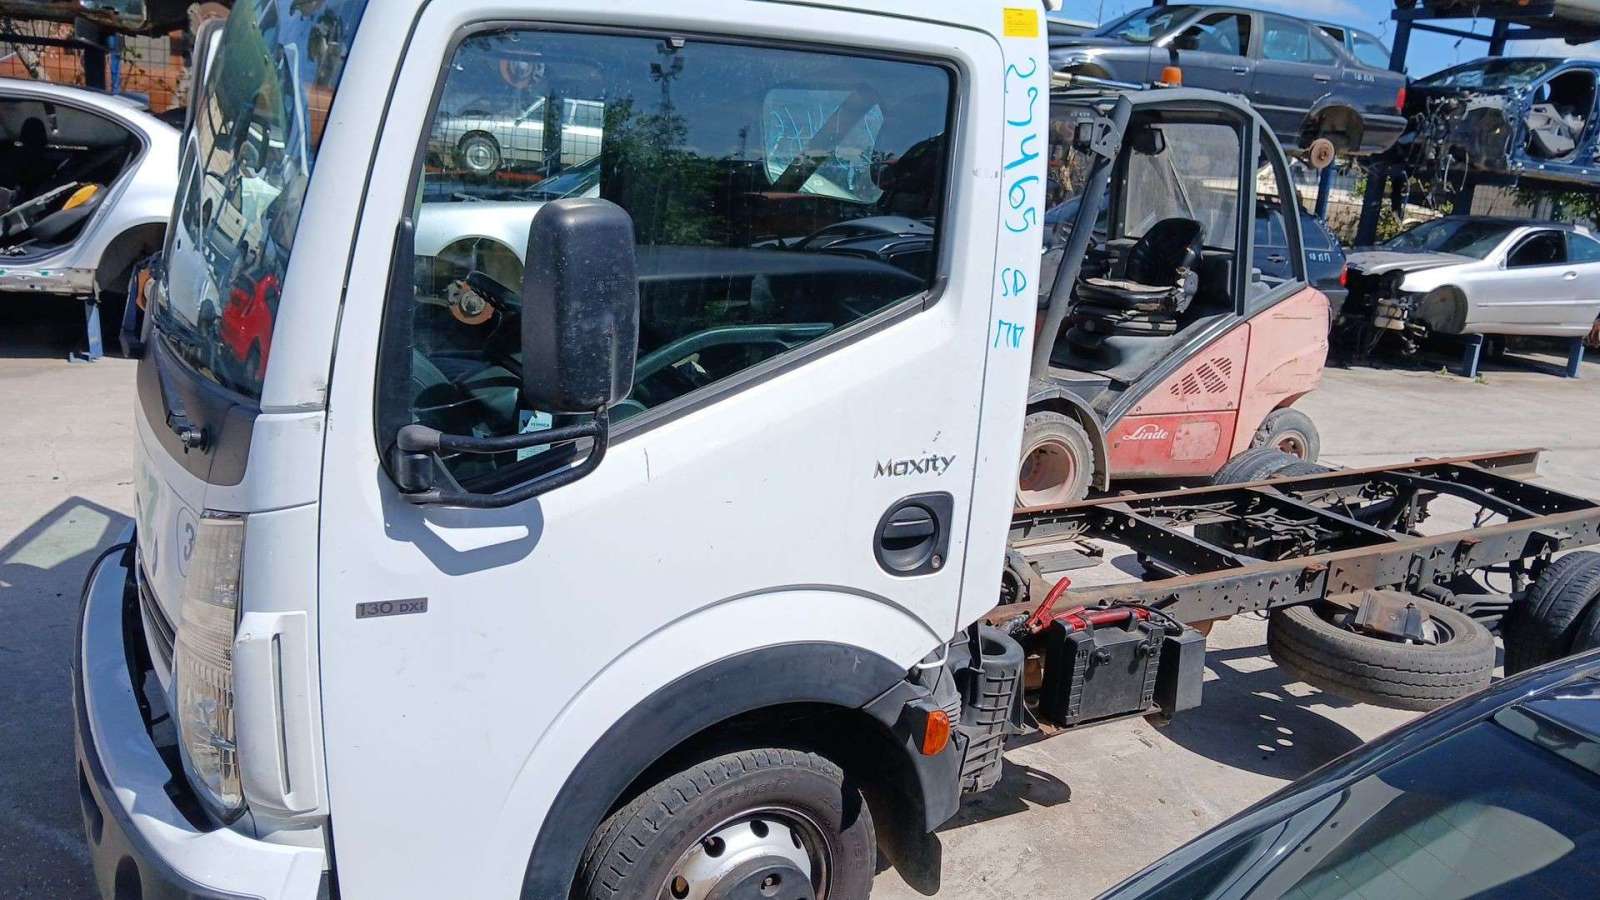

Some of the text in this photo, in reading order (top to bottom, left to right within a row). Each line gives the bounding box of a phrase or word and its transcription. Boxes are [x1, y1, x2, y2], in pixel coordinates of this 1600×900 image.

[1122, 423, 1169, 441] Linde
[873, 451, 957, 479] Maxity
[359, 602, 394, 616] 130
